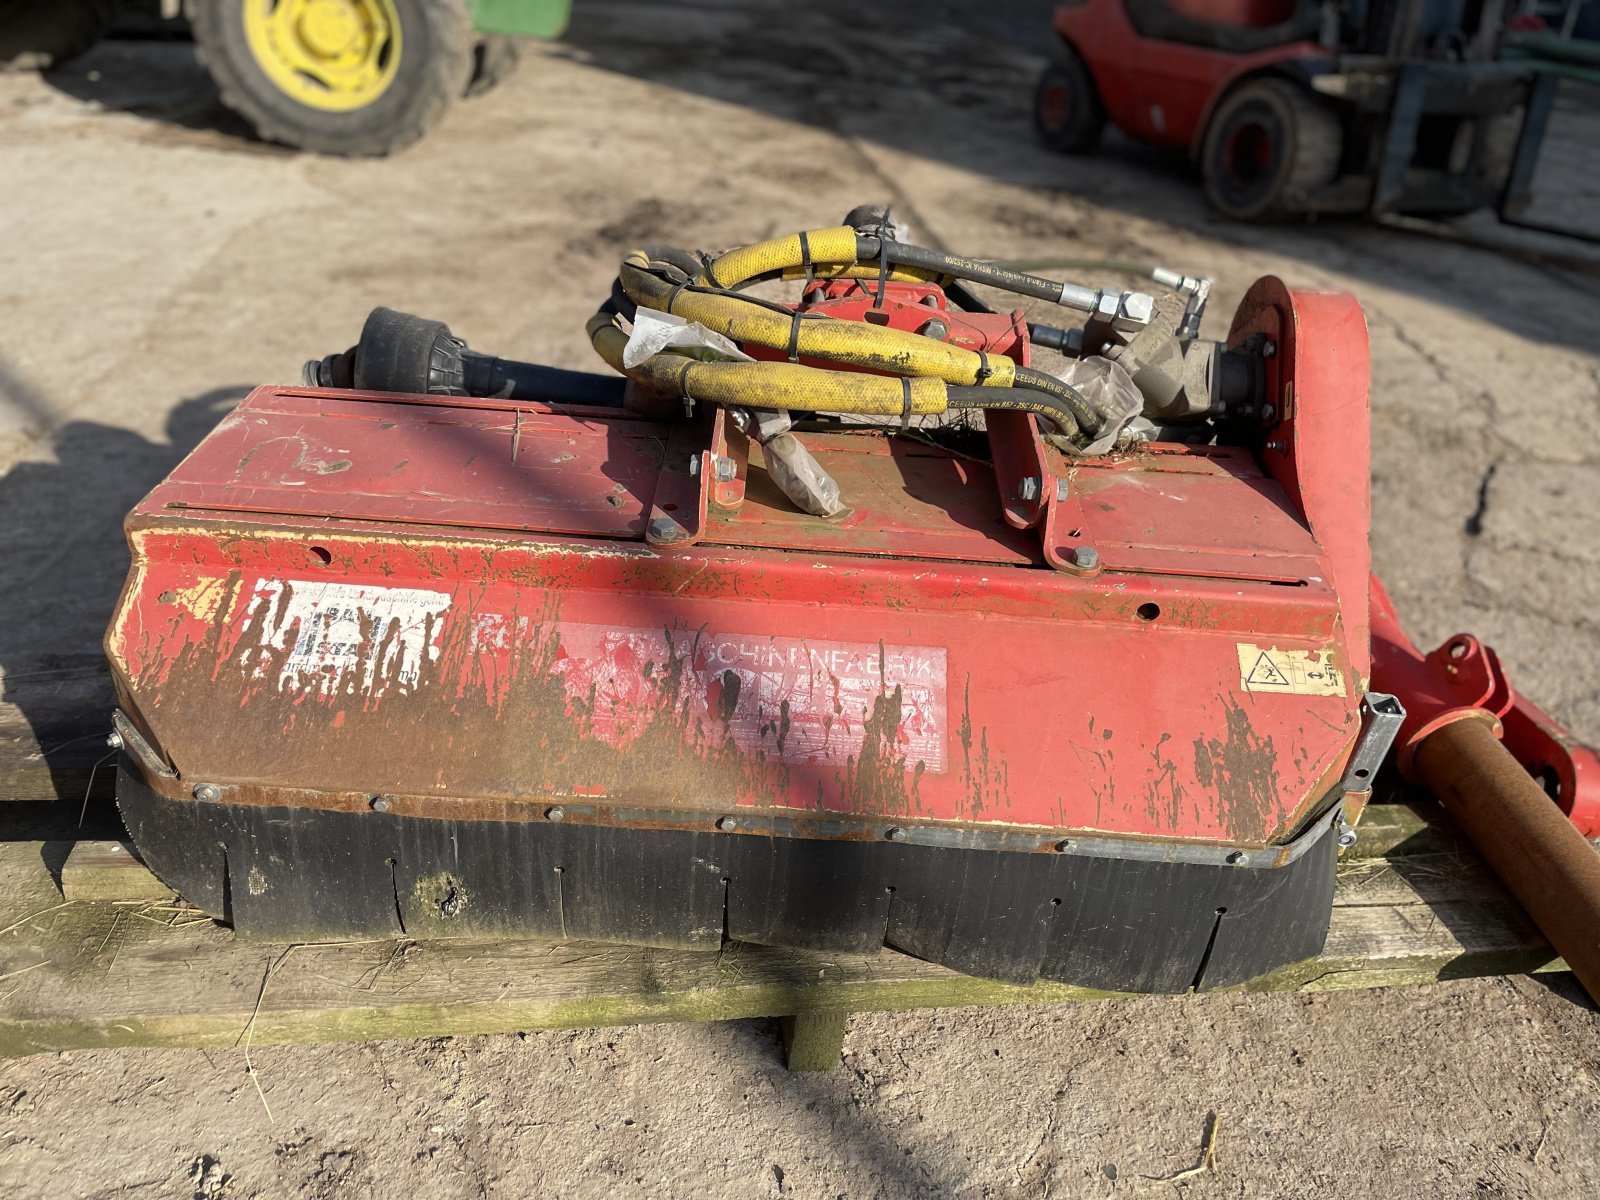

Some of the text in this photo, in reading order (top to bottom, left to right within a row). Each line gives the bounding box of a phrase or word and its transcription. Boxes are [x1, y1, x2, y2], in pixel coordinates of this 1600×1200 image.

[973, 263, 992, 275] MSHA
[1027, 277, 1046, 288] Flame
[1037, 378, 1048, 389] DIN
[1046, 382, 1055, 391] EN
